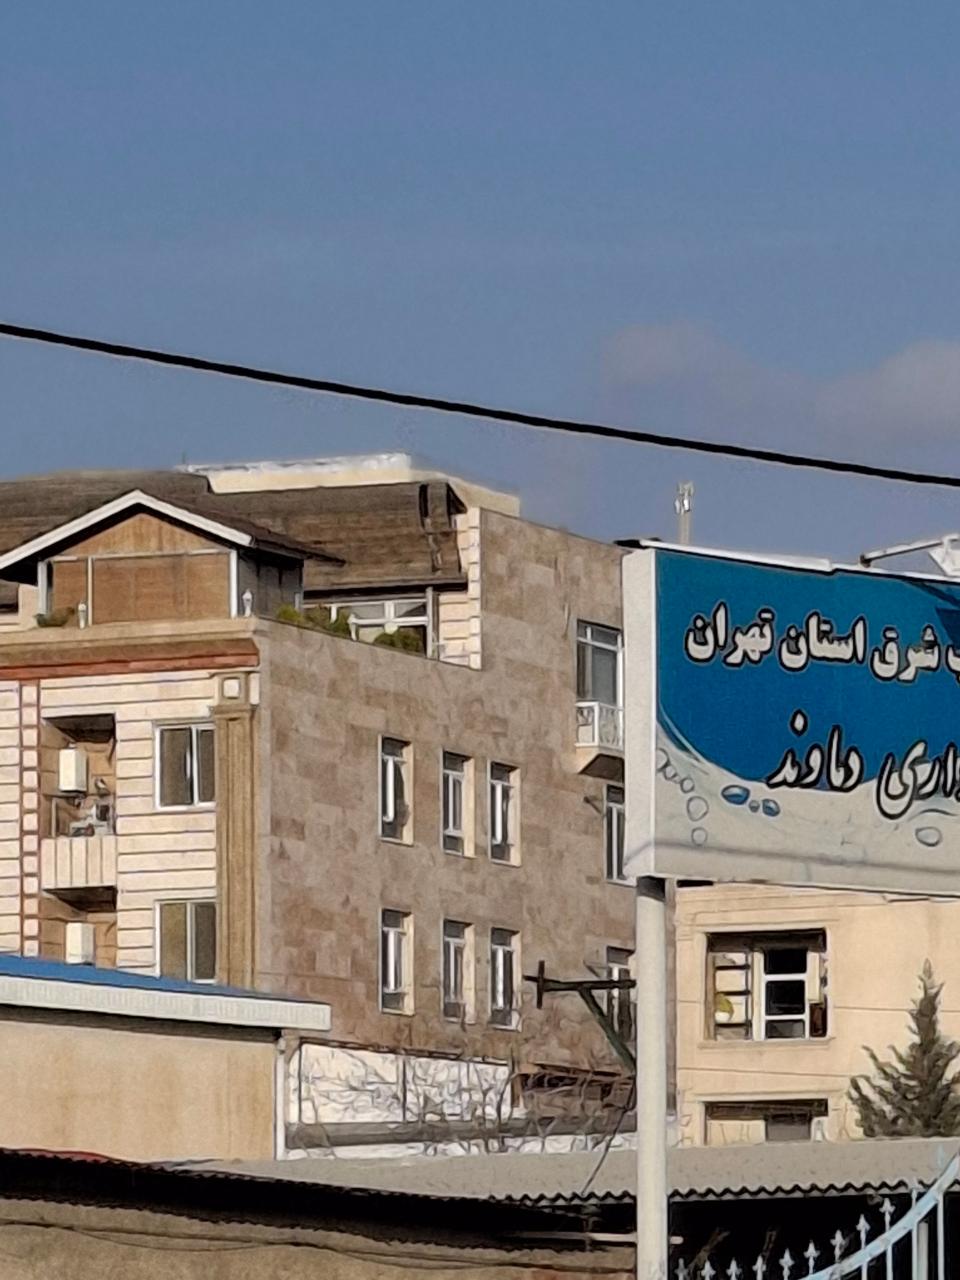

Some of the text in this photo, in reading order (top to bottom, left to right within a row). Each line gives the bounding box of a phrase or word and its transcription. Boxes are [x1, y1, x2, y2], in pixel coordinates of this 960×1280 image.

[684, 601, 775, 667] تهران
[777, 609, 866, 672] استان
[870, 623, 940, 682] شرق
[766, 709, 864, 793] دماوند
